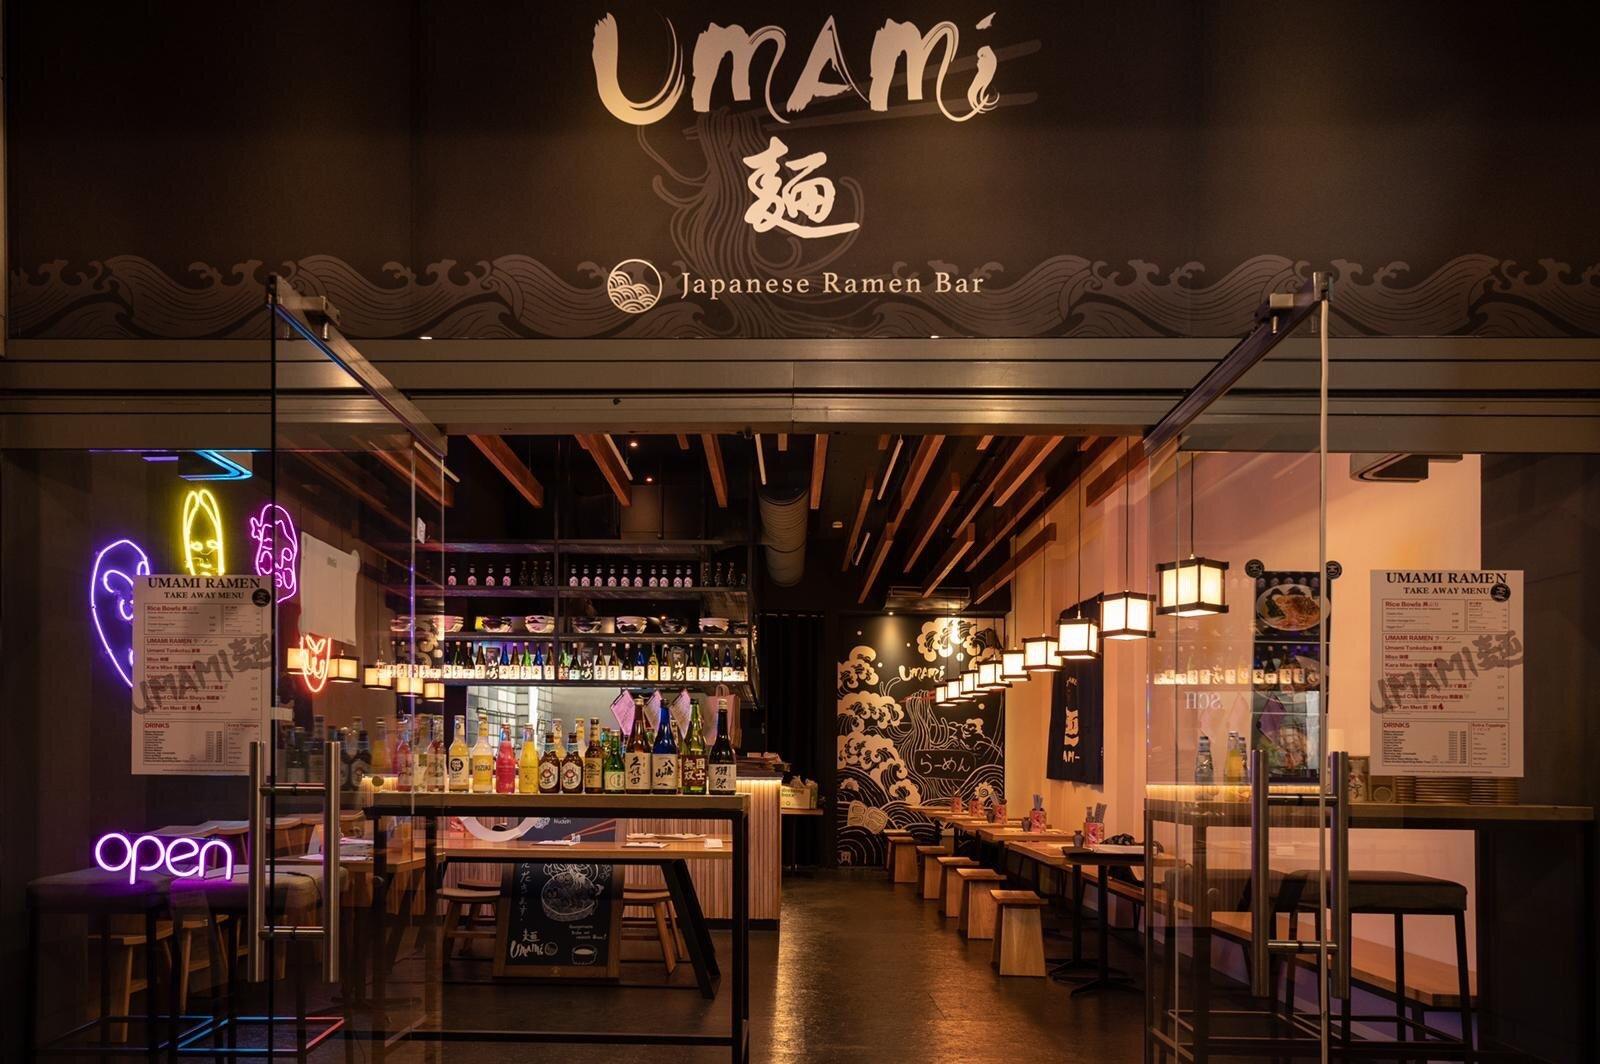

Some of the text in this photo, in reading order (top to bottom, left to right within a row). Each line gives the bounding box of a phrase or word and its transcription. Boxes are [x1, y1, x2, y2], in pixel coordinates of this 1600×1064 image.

[680, 271, 985, 300] Japanese Ramen Bar
[147, 577, 261, 589] UMAMI RAMEN
[1385, 572, 1508, 584] UMAMI RAMEN
[164, 591, 245, 599] TAKE AWAY MENU
[1402, 587, 1490, 595] TAKE AWAY MENU
[920, 753, 971, 775] らーめん
[95, 832, 233, 885] open
